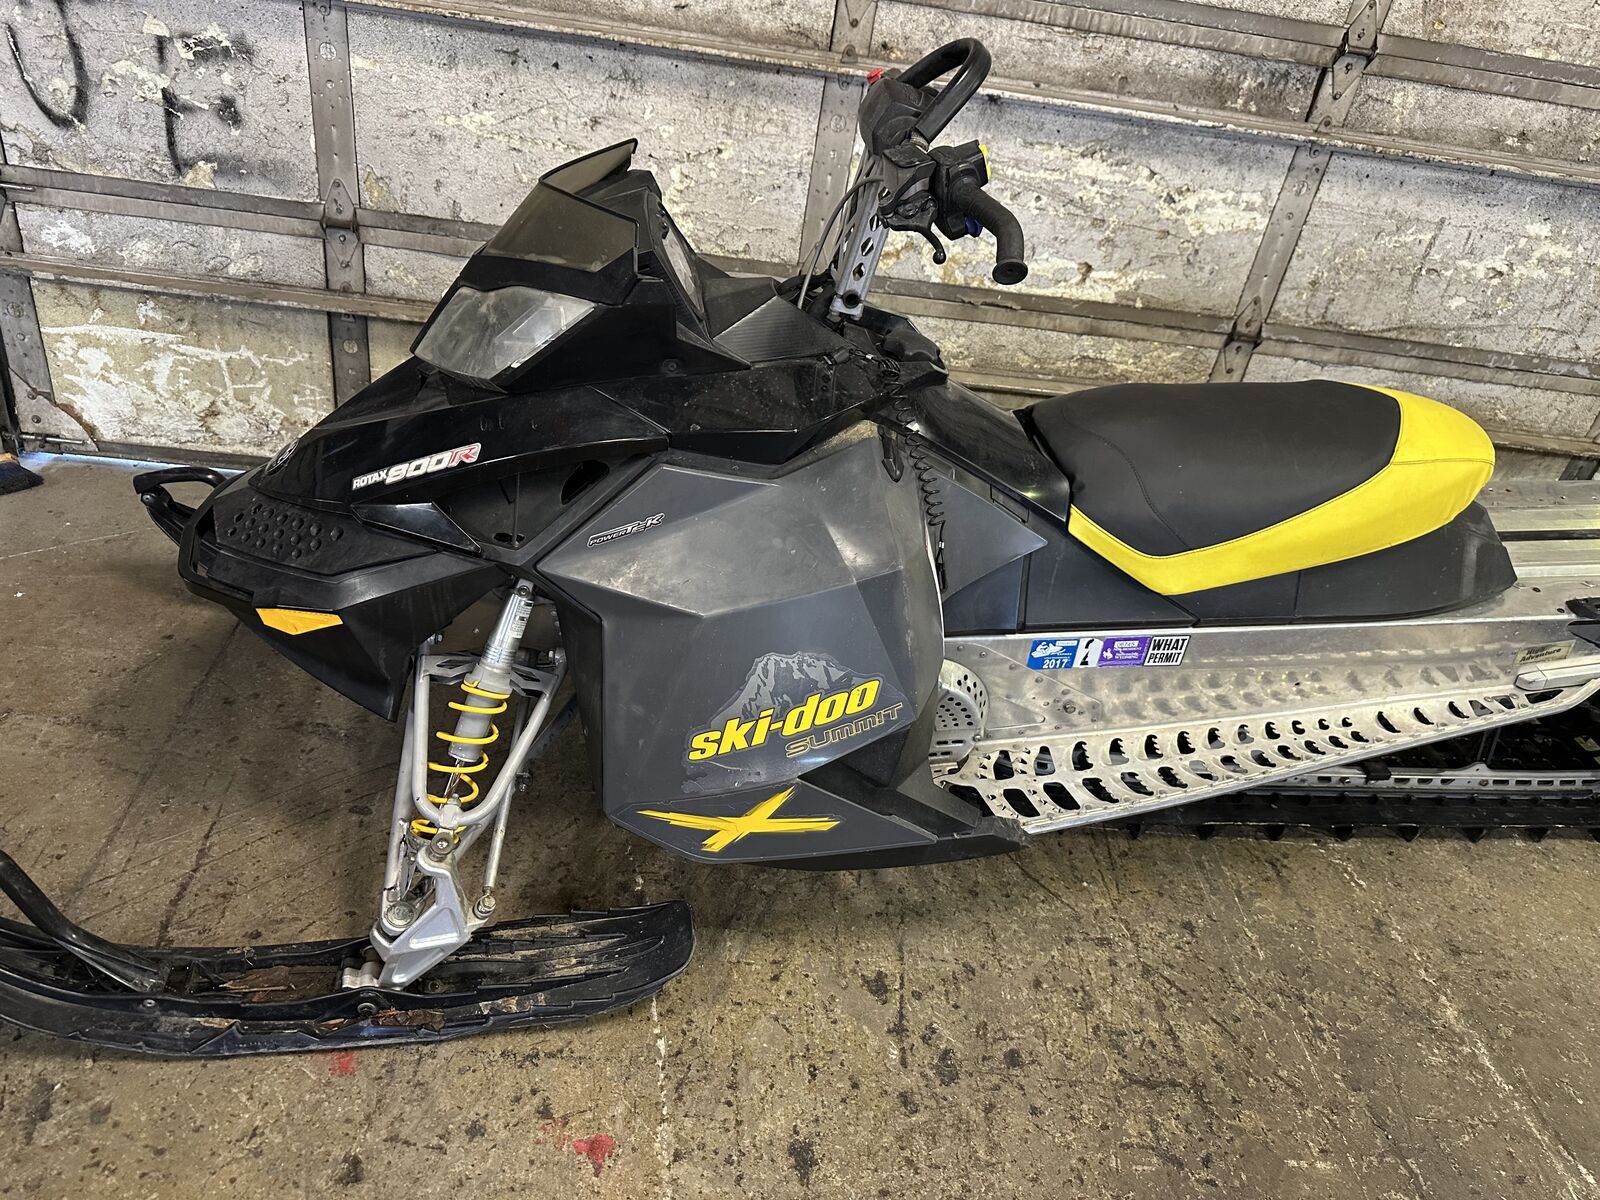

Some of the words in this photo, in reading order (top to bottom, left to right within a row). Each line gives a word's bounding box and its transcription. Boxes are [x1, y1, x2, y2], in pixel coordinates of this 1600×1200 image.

[352, 468, 388, 490] ROTAX
[1152, 638, 1188, 651] WHAT
[1042, 659, 1068, 669] 2017
[1147, 652, 1182, 664] PERMIT
[687, 679, 882, 761] ski-doo
[785, 702, 903, 758] SUMMIT
